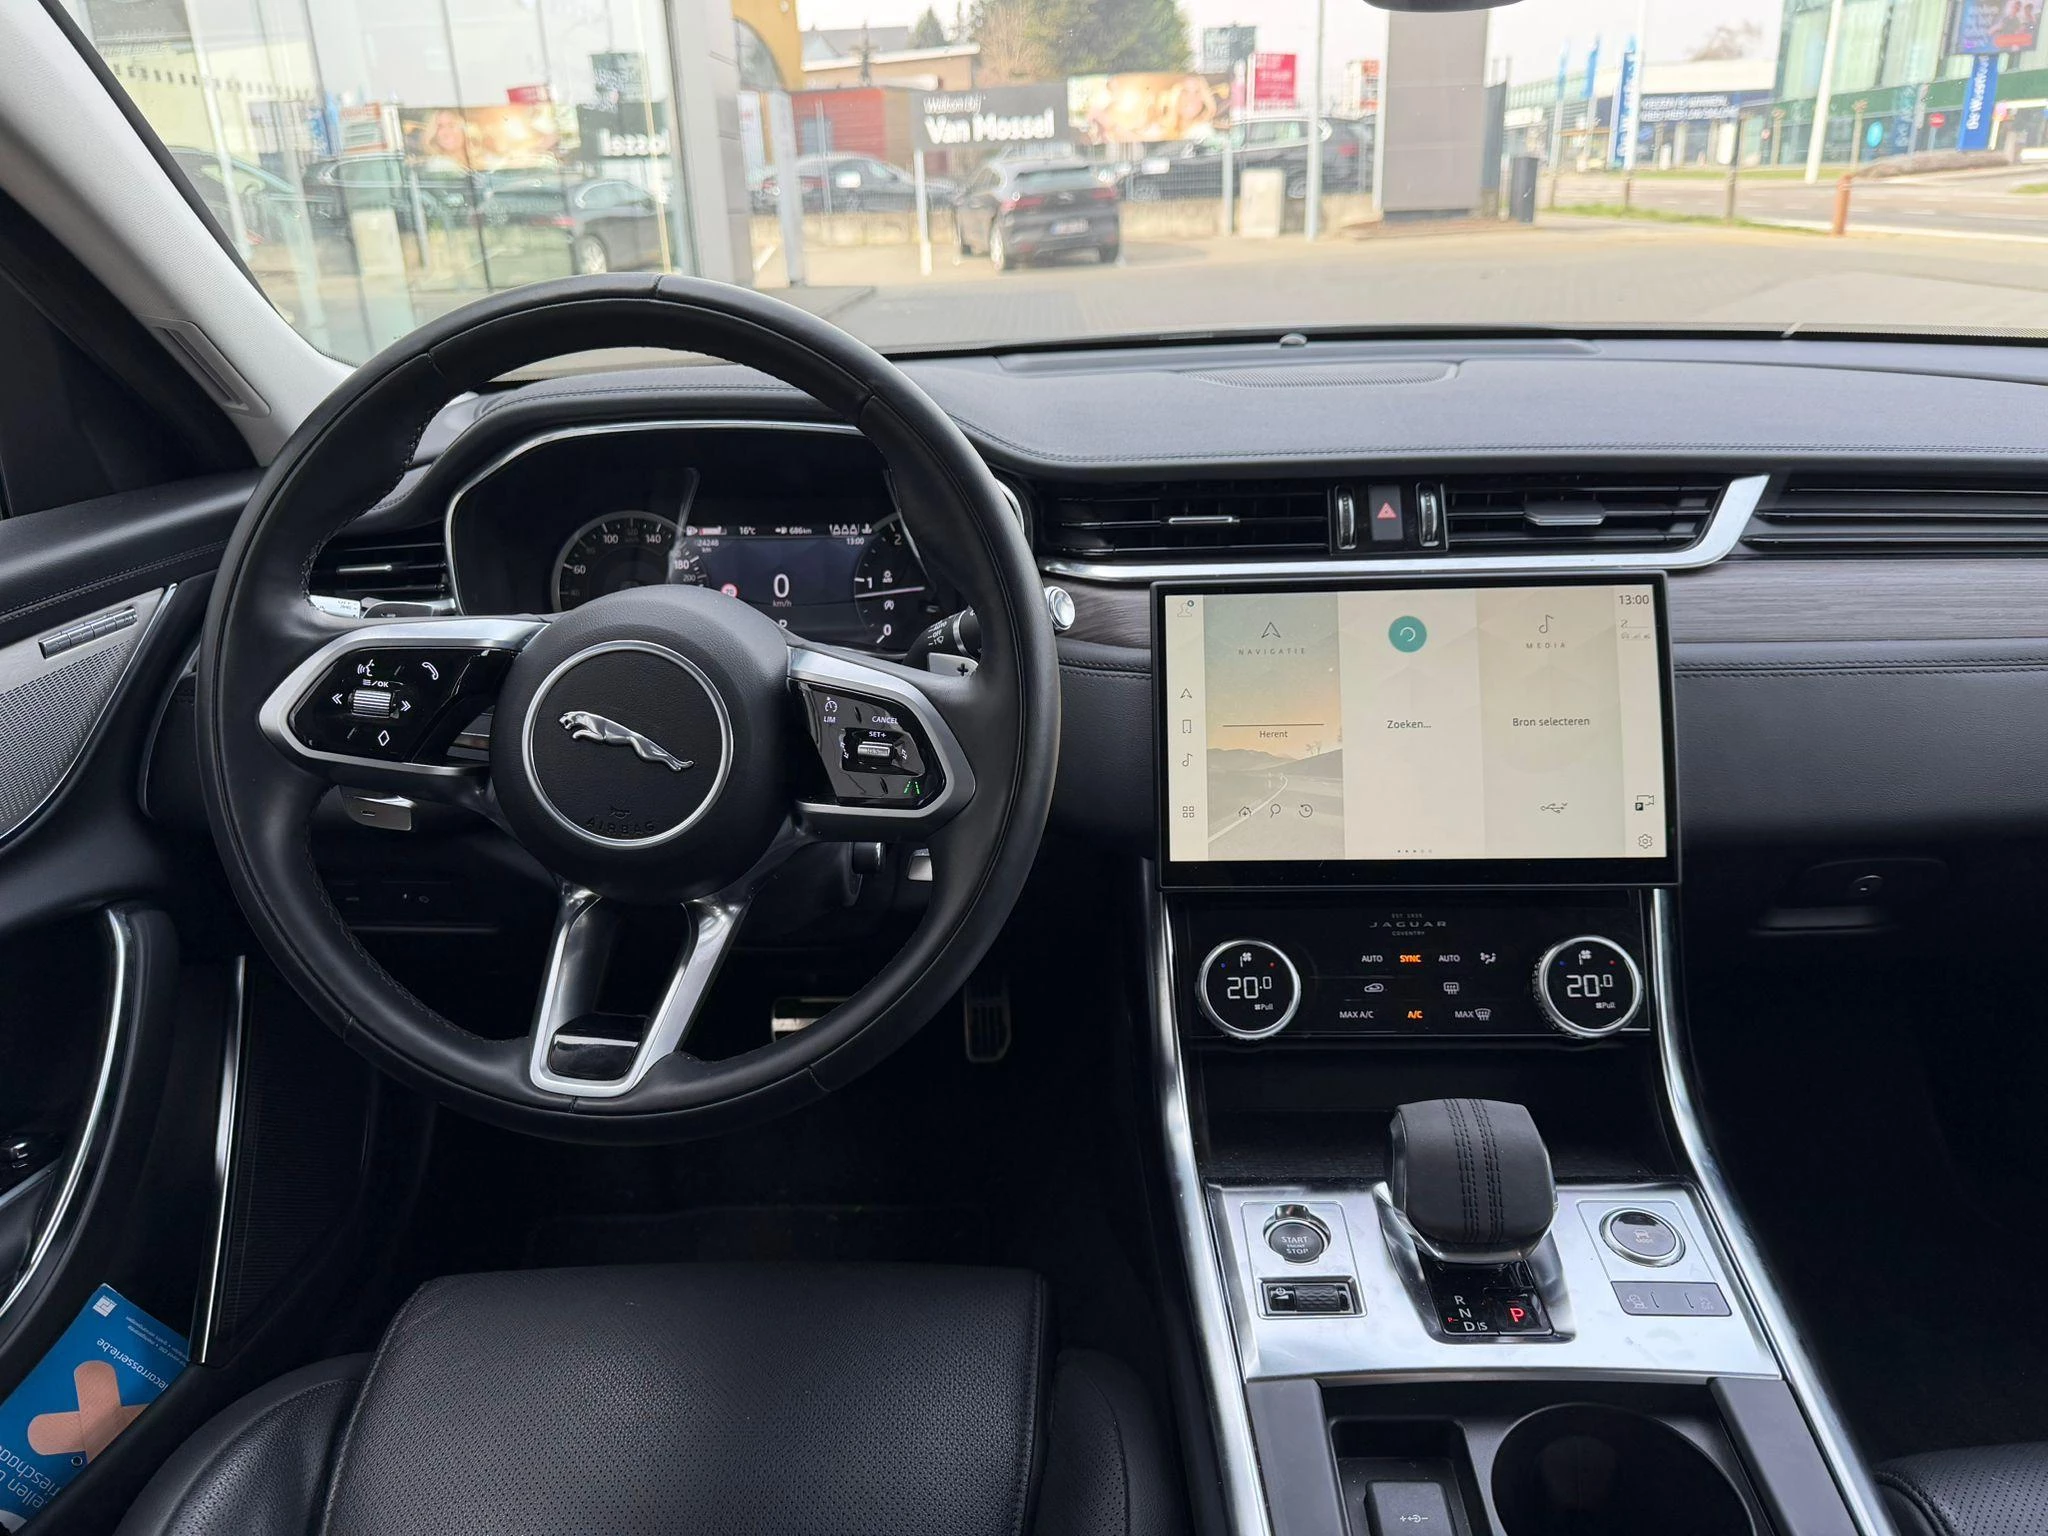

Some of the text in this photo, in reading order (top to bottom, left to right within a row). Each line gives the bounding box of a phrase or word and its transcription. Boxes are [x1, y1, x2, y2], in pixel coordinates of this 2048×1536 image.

[924, 106, 1055, 144] Van Mossel
[603, 534, 619, 544] 100
[645, 534, 662, 543] 140
[846, 537, 865, 545] 13:00
[894, 533, 902, 545] 2
[573, 565, 587, 575] 60
[674, 560, 690, 570] 180
[683, 574, 696, 582] 200
[866, 577, 873, 589] 1
[773, 573, 790, 598] 0
[772, 599, 793, 607] km/h
[1619, 594, 1650, 605] 13:00
[883, 624, 892, 636] 0
[1238, 647, 1305, 656] NAVIGATIE
[823, 715, 837, 723] LIM
[871, 715, 899, 725] CANCEL
[1512, 716, 1590, 727] Bron selecteren
[1387, 720, 1432, 729] Zoeken...
[1259, 730, 1288, 738] Herent
[1361, 954, 1461, 963] AUTO SYNC AUTO
[1226, 976, 1272, 999] 20.0
[1566, 974, 1613, 998] 20.0
[1339, 1011, 1374, 1019] MAX A/C
[1407, 1011, 1423, 1019] A/C
[1454, 1010, 1474, 1018] MAX
[1454, 1295, 1466, 1305] R
[1459, 1308, 1472, 1319] N
[1510, 1307, 1525, 1322] P
[1464, 1322, 1475, 1331] D
